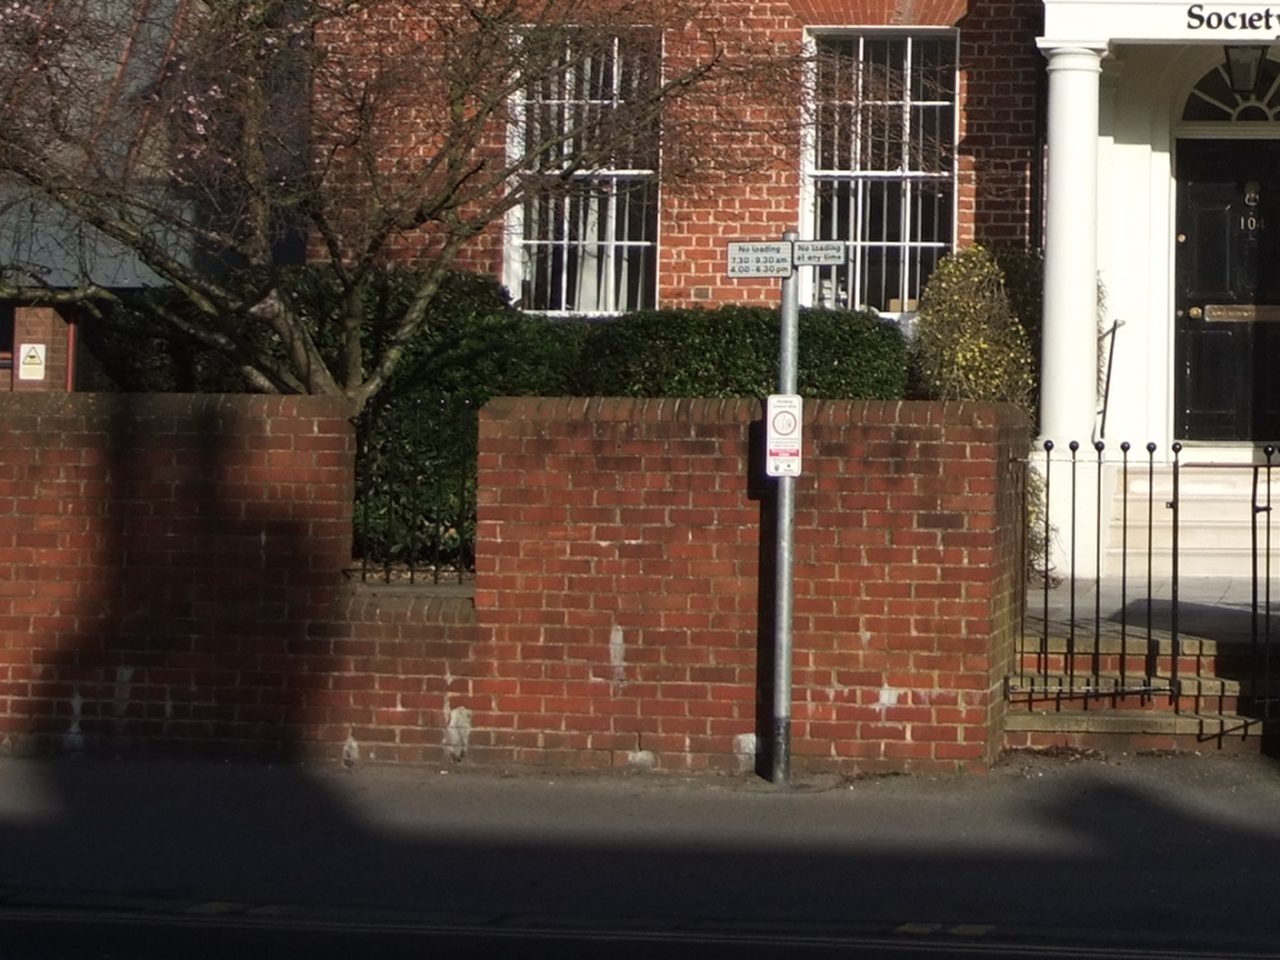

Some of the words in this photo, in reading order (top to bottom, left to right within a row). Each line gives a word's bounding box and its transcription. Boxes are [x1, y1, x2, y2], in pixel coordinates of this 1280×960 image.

[752, 245, 781, 254] loading
[798, 244, 809, 252] No
[811, 244, 841, 253] loading
[796, 254, 805, 262] at
[824, 253, 841, 261] time
[775, 266, 789, 274] pm
